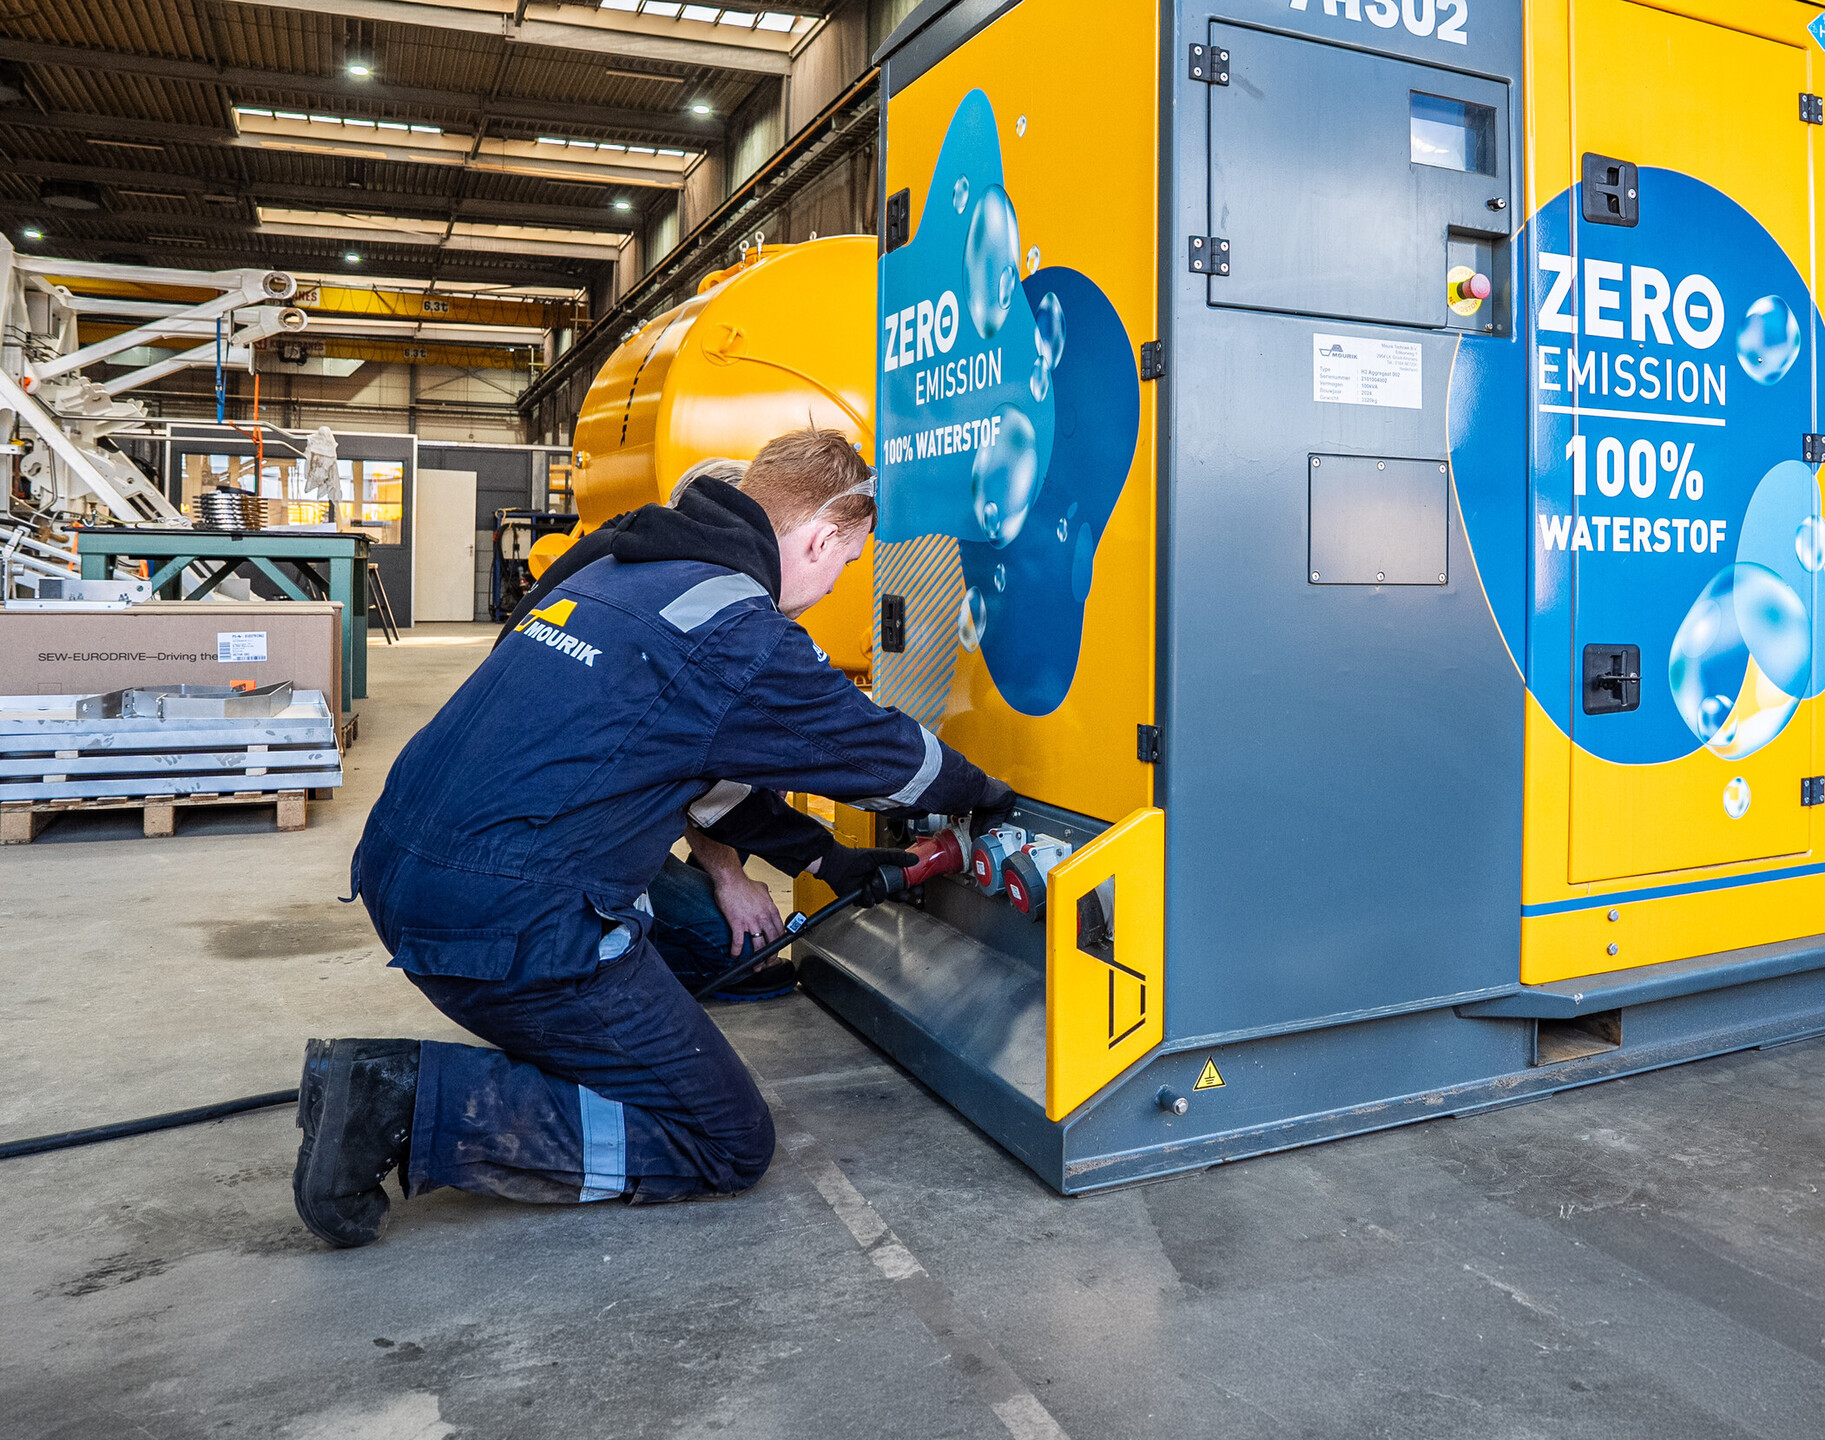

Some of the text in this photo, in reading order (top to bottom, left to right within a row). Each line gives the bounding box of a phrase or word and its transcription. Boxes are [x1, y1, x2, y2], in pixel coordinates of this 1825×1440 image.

[1538, 251, 1725, 350] ZERO
[884, 290, 959, 372] ZERO
[915, 348, 1001, 406] EMISSION
[1538, 345, 1726, 406] EMISSION
[884, 415, 1001, 465] 100% WATERSTOF
[1565, 434, 1704, 501] 100%
[1538, 514, 1727, 554] WATERSTOF
[200, 652, 218, 662] the
[523, 620, 603, 668] MOURIK
